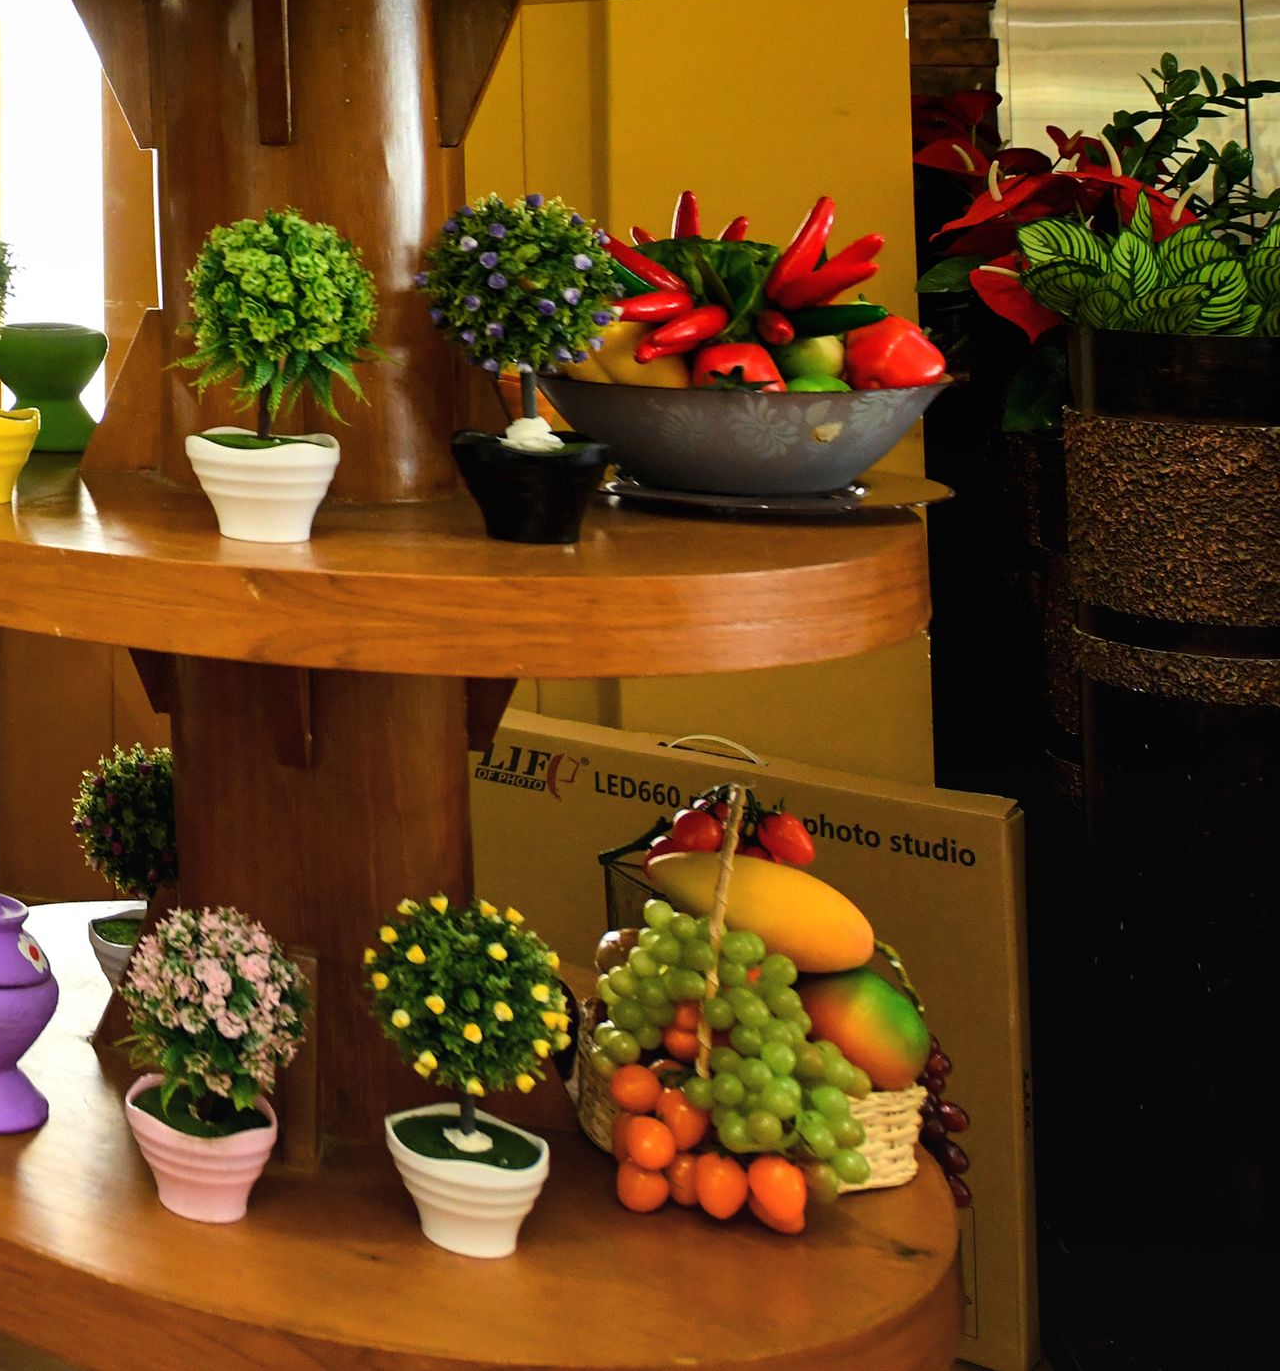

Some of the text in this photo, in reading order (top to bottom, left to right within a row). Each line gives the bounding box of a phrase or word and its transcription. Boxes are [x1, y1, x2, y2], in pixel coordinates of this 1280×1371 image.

[477, 769, 544, 791] OF PHOTO
[594, 771, 681, 808] LED660
[802, 813, 881, 849] photo
[889, 832, 977, 868] studio
